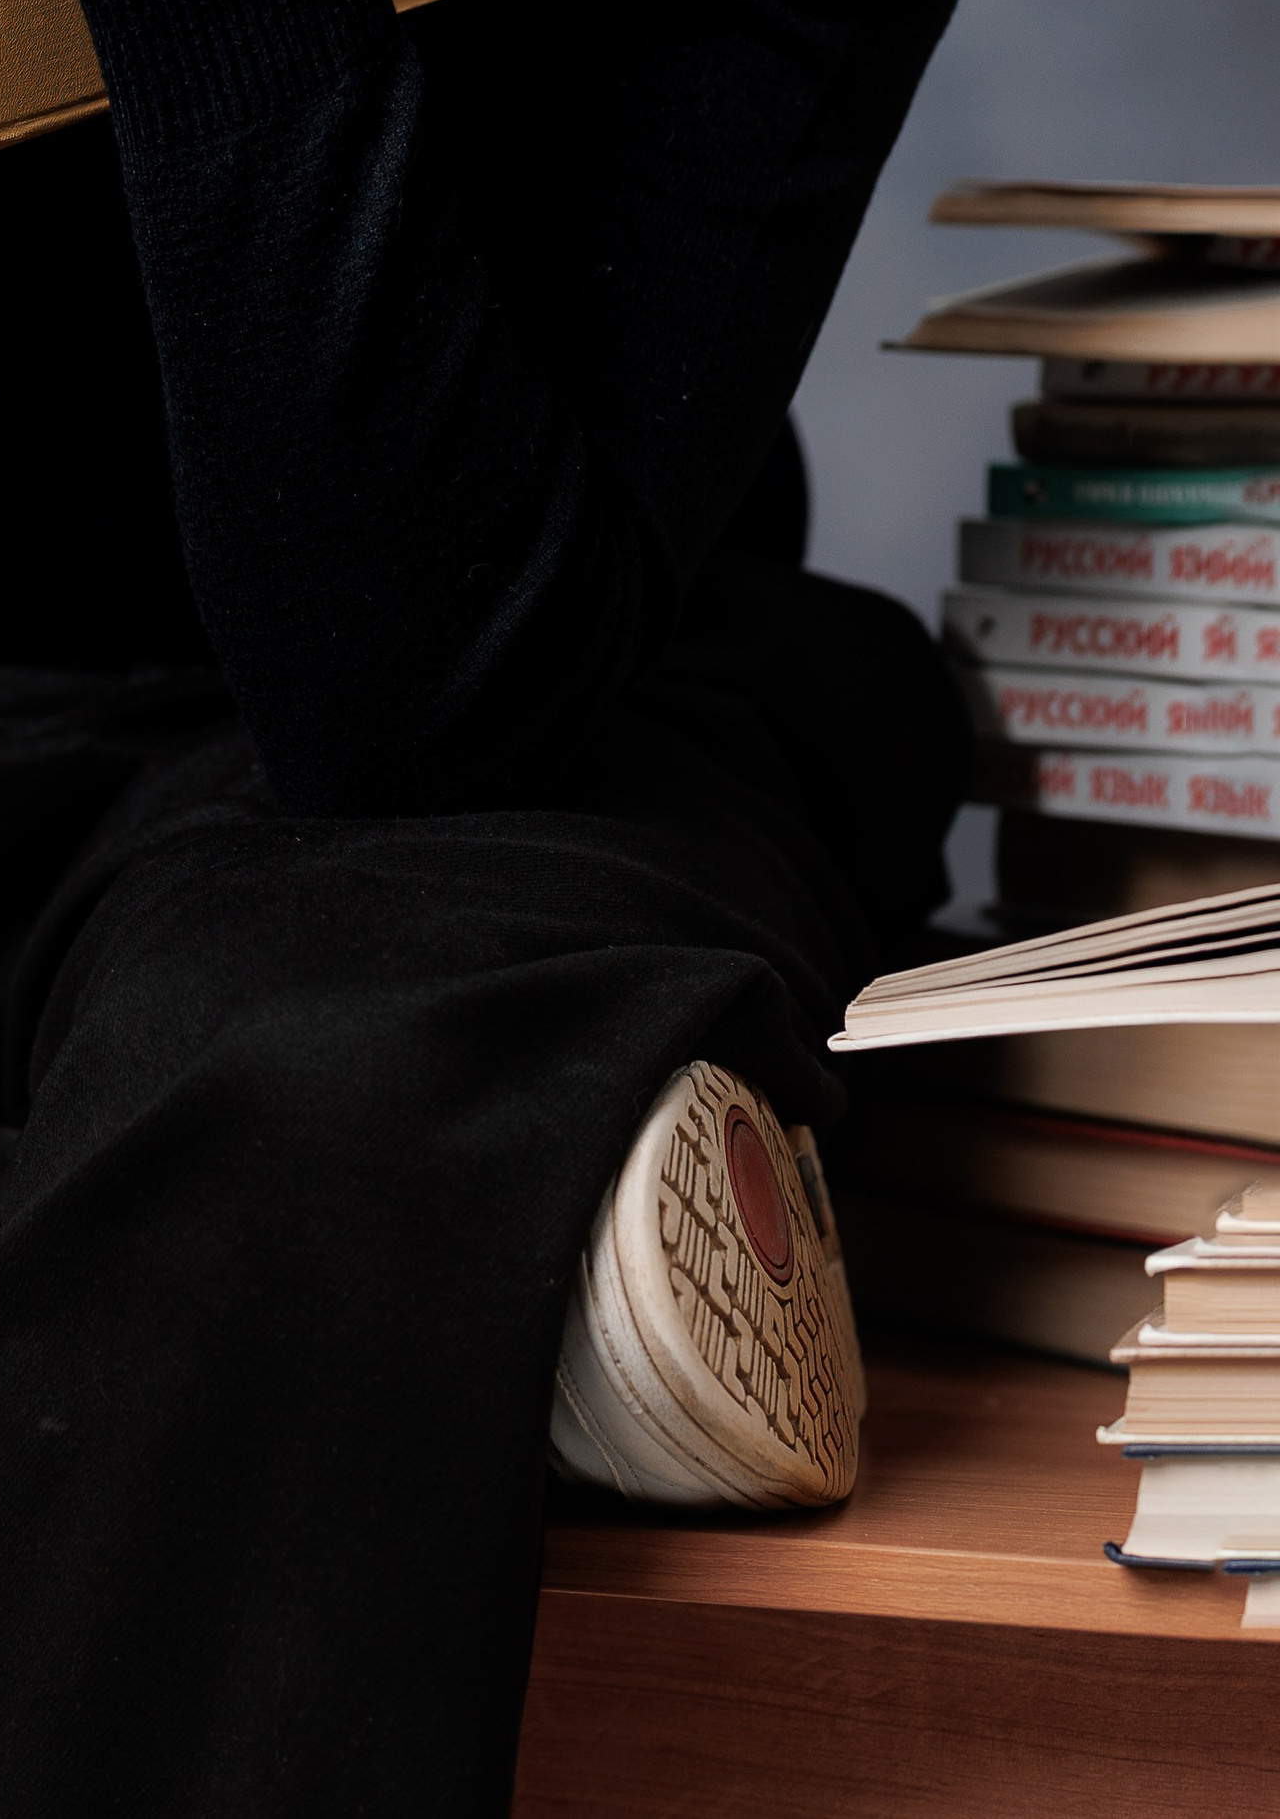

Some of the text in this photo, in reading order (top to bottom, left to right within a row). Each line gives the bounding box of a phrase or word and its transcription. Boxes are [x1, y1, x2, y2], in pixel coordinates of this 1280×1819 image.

[1030, 613, 1179, 661] РУССКИЙ
[998, 688, 1147, 735] РУССКИЙ
[1187, 774, 1271, 819] ЯЗЫК
